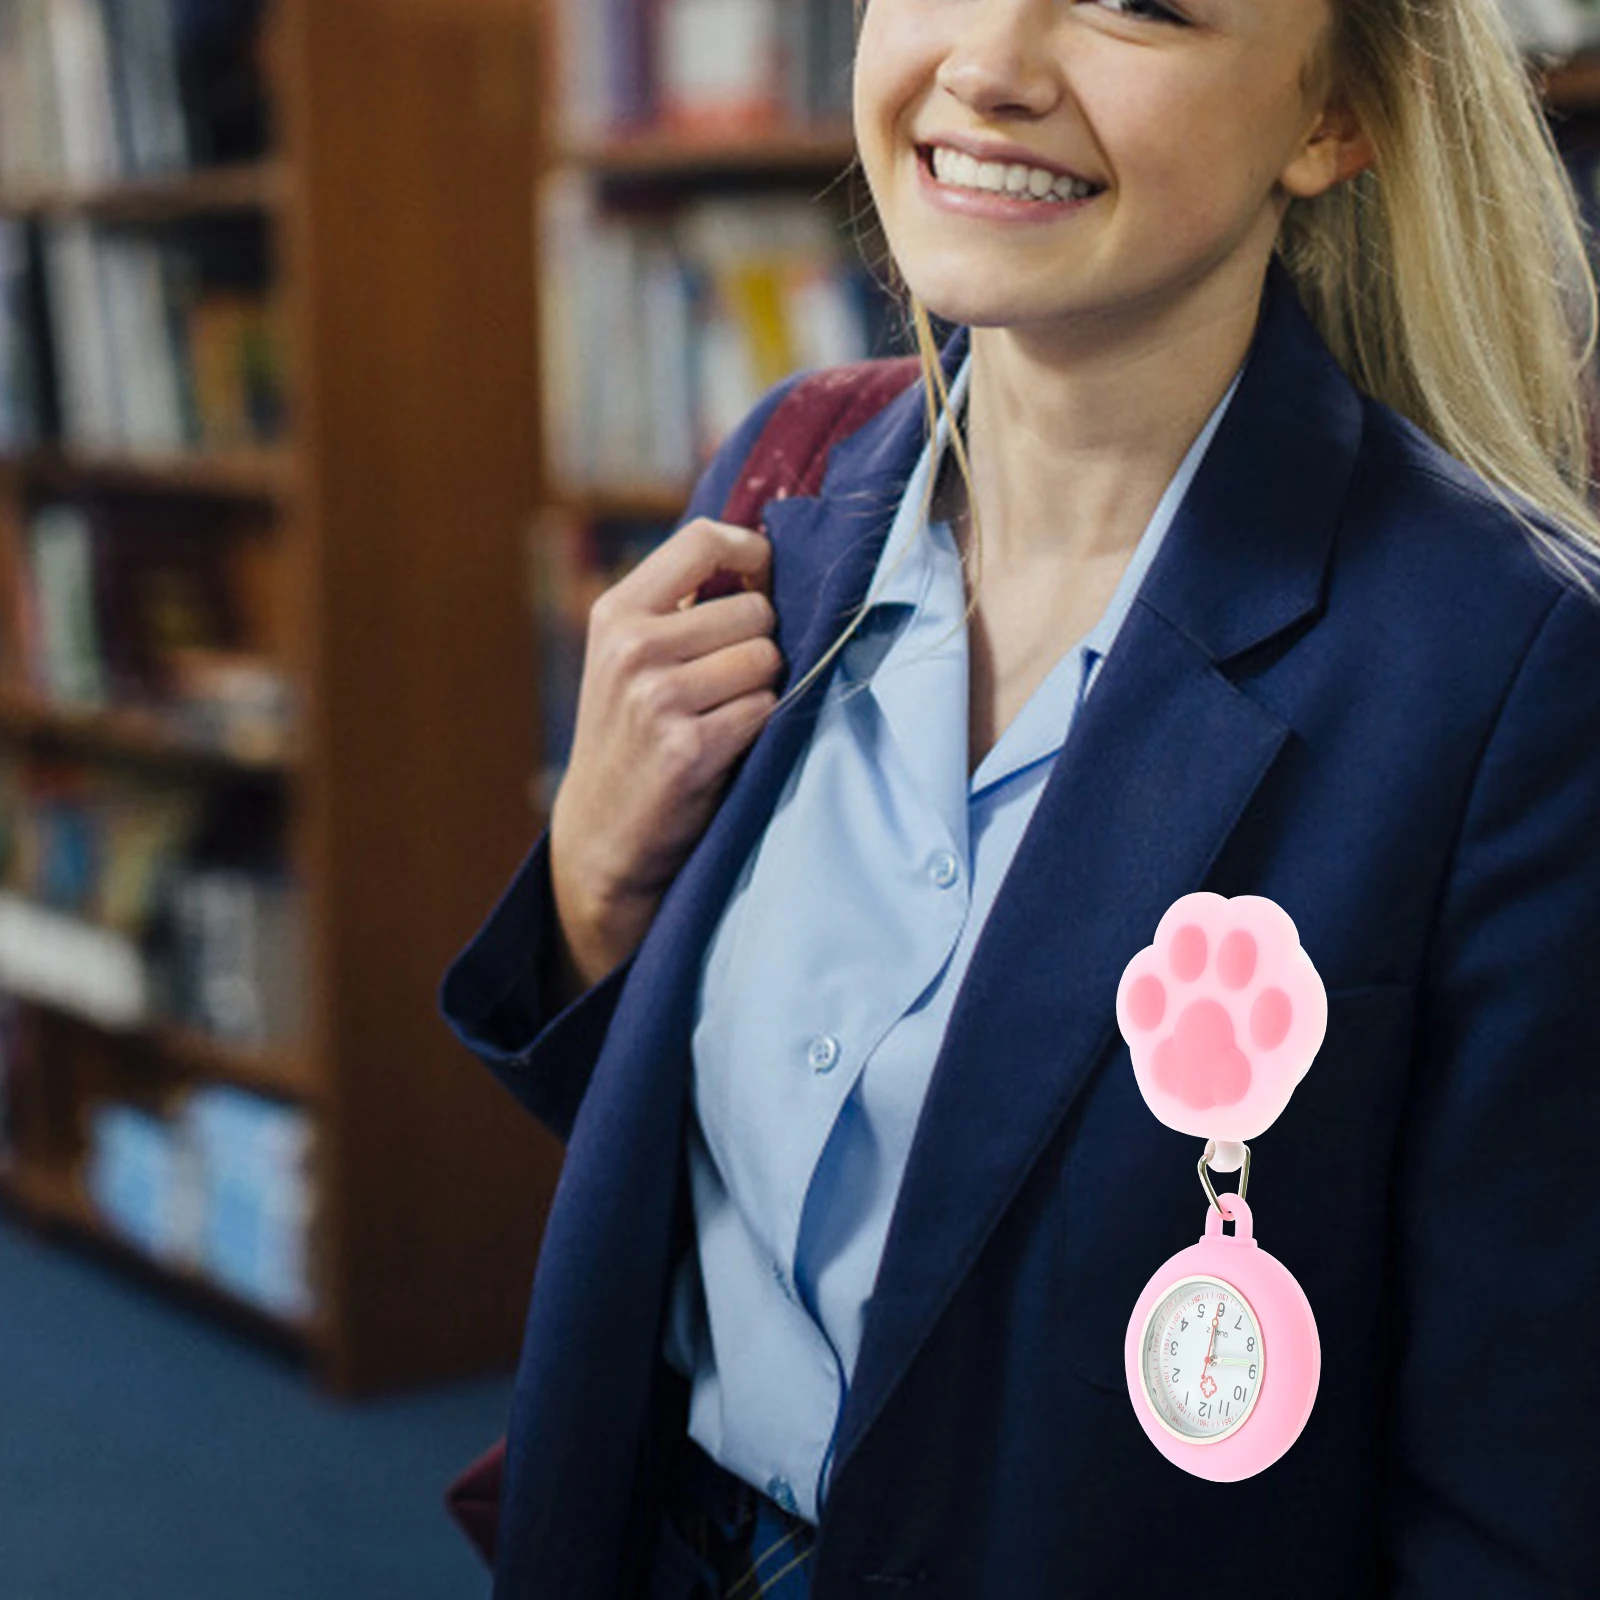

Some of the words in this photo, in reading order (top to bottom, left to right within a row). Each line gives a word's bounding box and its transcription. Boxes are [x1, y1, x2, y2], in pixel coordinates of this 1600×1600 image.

[1197, 1304, 1206, 1318] 5
[1217, 1302, 1225, 1317] 6
[1181, 1317, 1189, 1332] 4
[1234, 1315, 1242, 1330] 7
[1206, 1327, 1228, 1338] QUAZ
[1170, 1341, 1178, 1356] 3
[1246, 1336, 1255, 1352] 8
[1172, 1368, 1180, 1383] 2
[1248, 1364, 1256, 1380] 9
[1185, 1391, 1189, 1406] 1
[1234, 1386, 1247, 1402] 10
[1198, 1401, 1212, 1419] 12
[1219, 1400, 1230, 1416] 11
